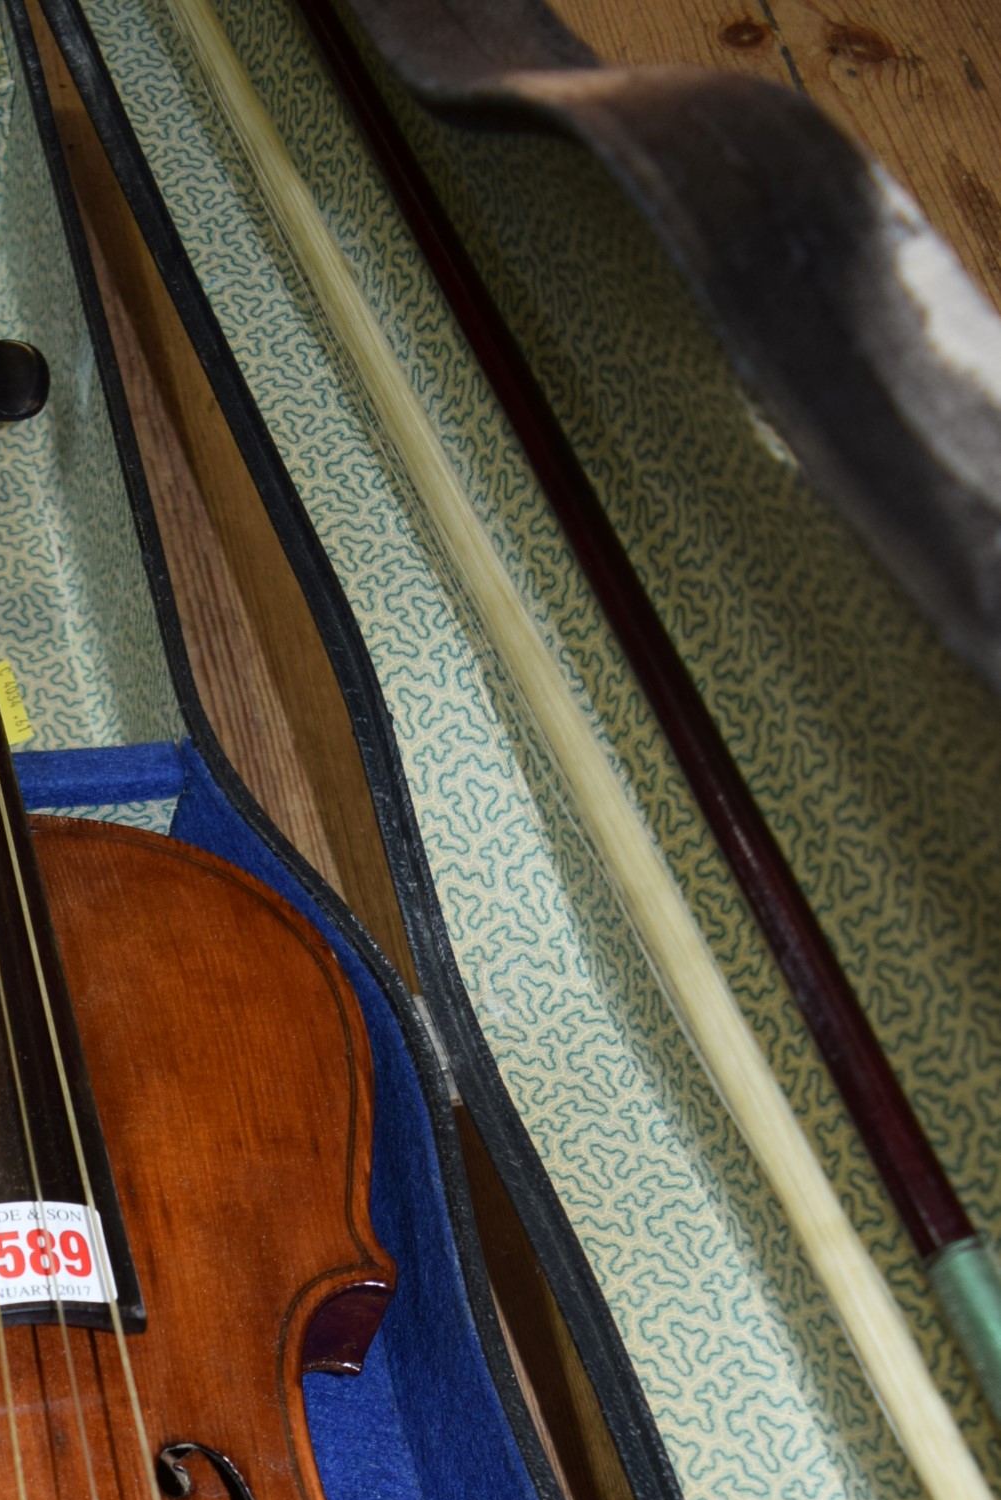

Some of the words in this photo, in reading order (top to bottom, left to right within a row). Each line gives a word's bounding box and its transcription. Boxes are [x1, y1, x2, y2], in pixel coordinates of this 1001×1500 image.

[26, 1209, 42, 1221] &
[46, 1208, 82, 1222] SON
[58, 1284, 92, 1297] 2017
